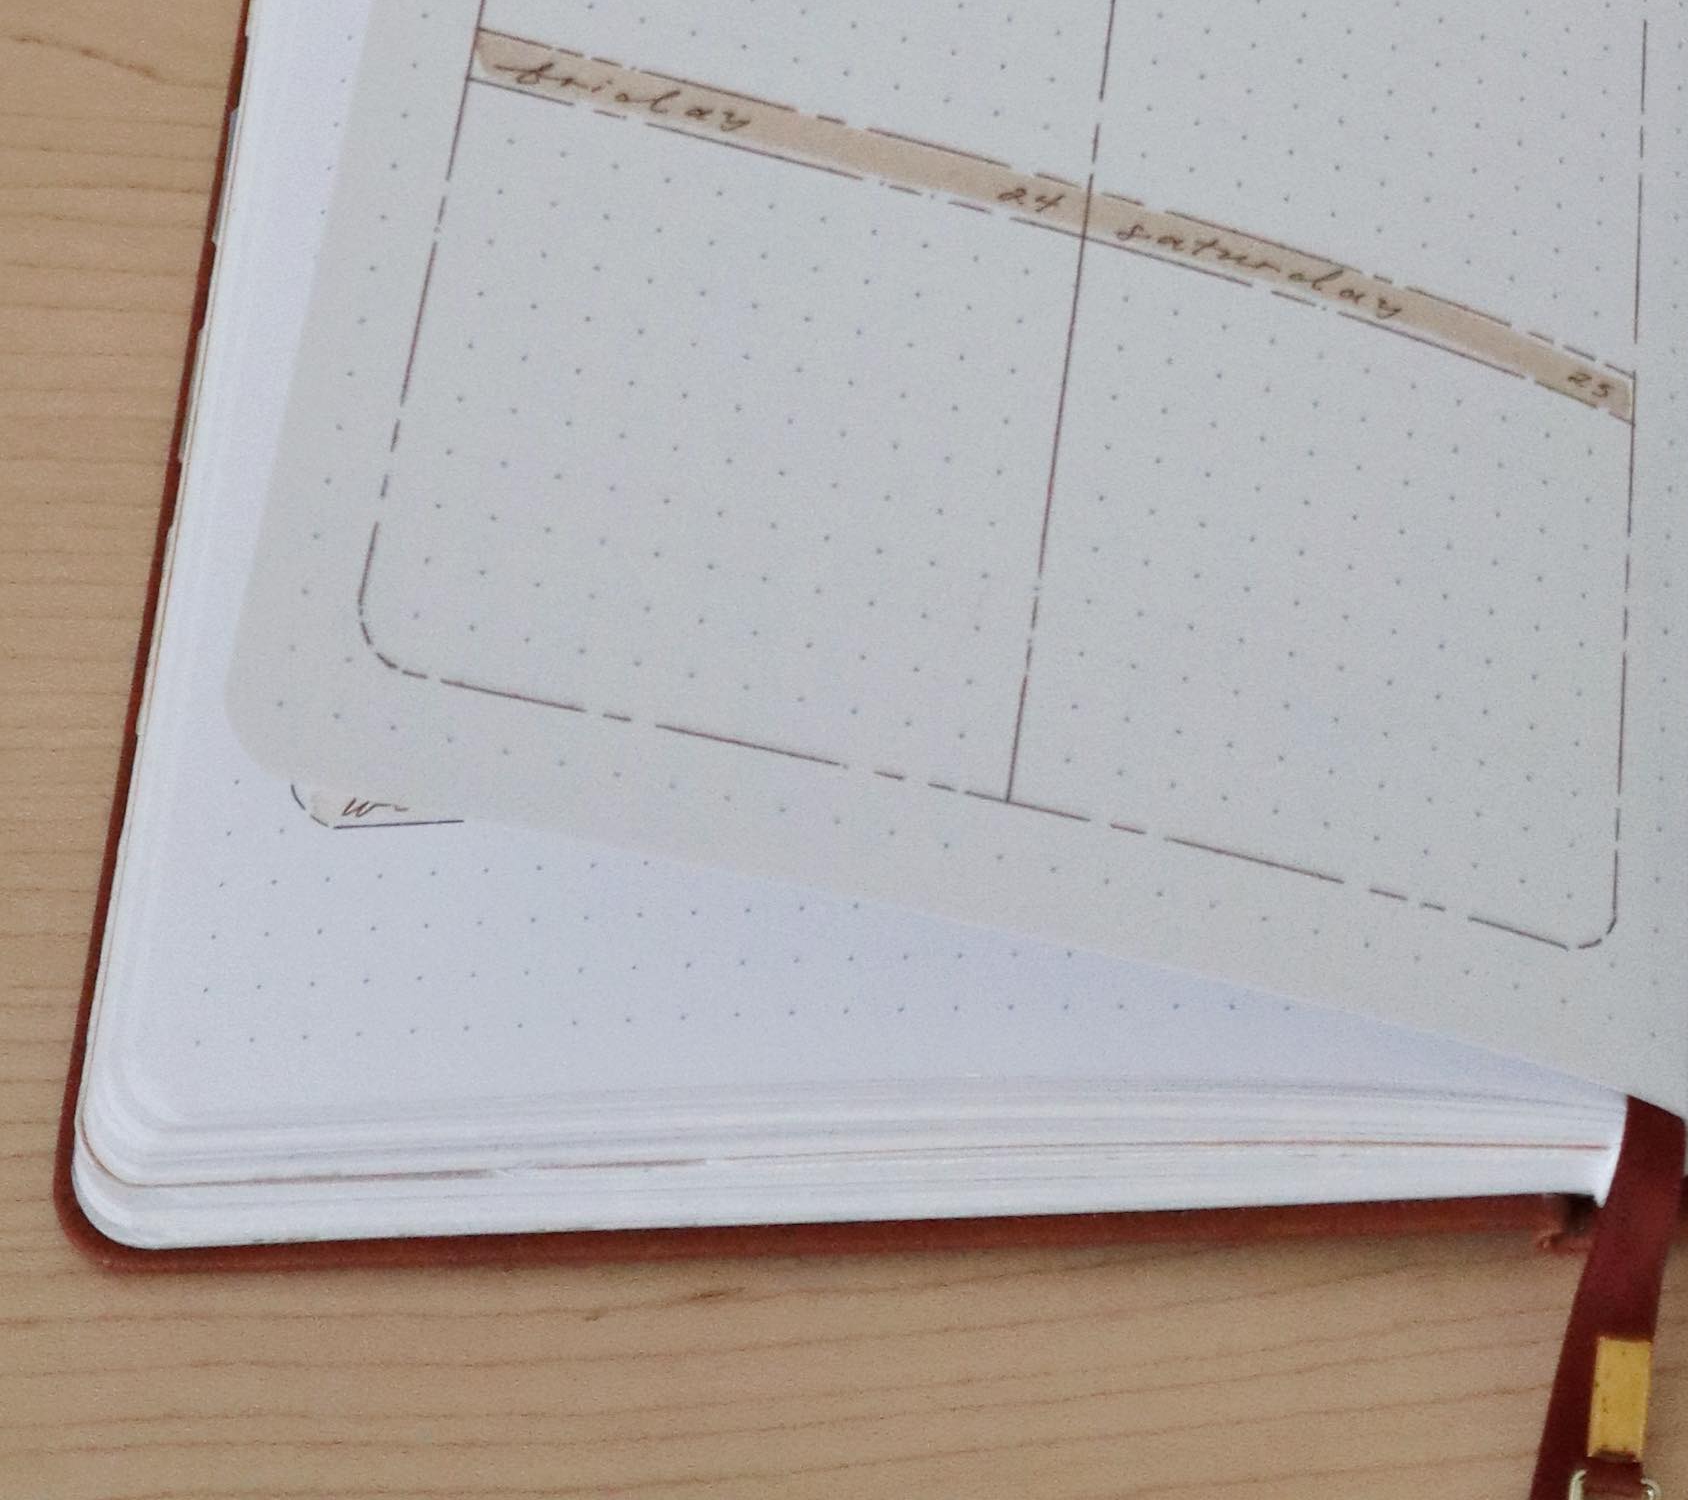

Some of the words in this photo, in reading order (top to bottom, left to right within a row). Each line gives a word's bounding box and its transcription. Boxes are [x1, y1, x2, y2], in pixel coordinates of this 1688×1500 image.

[494, 60, 751, 133] friday
[996, 186, 1066, 214] 24
[1115, 222, 1402, 320] saturday
[1567, 371, 1610, 399] 25
